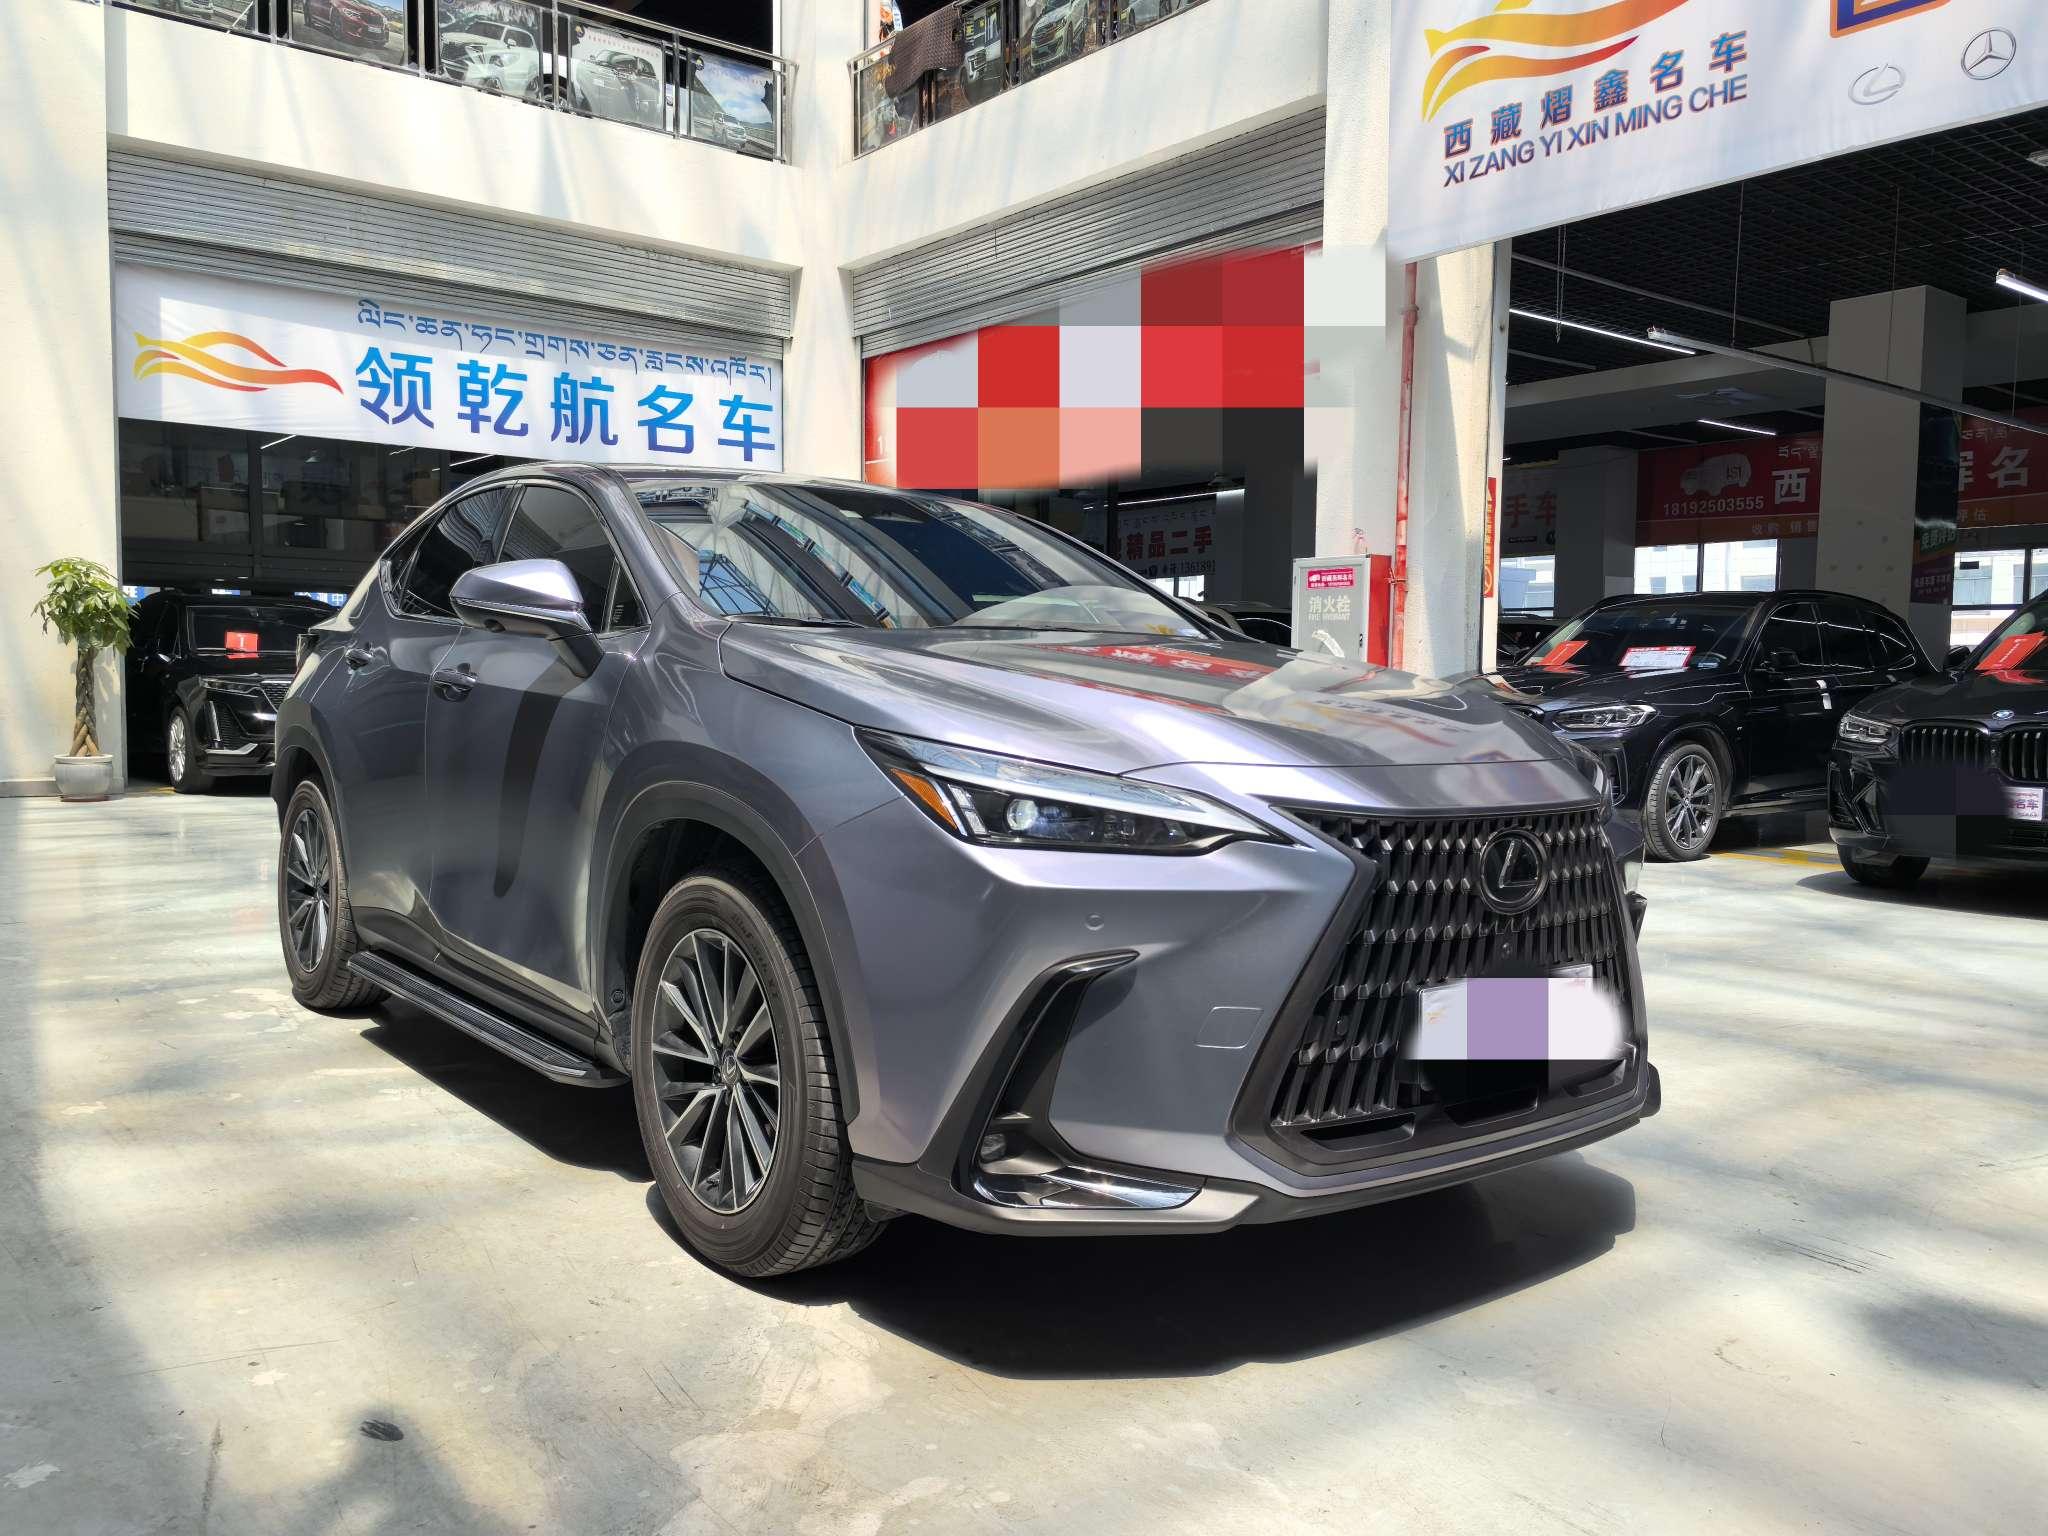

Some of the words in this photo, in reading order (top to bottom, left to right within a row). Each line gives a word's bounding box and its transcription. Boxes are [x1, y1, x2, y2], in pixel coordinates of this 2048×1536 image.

[1443, 30, 1747, 159] 西藏熠鑫名车
[1444, 161, 1465, 187] XI
[1469, 139, 1535, 179] ZANG
[1539, 130, 1563, 157] YI
[1567, 115, 1609, 151] XIN
[1615, 95, 1683, 137] MING
[1688, 74, 1748, 113] CHE
[355, 346, 776, 462] 领乾航名车
[1113, 525, 1213, 561] 精品二手
